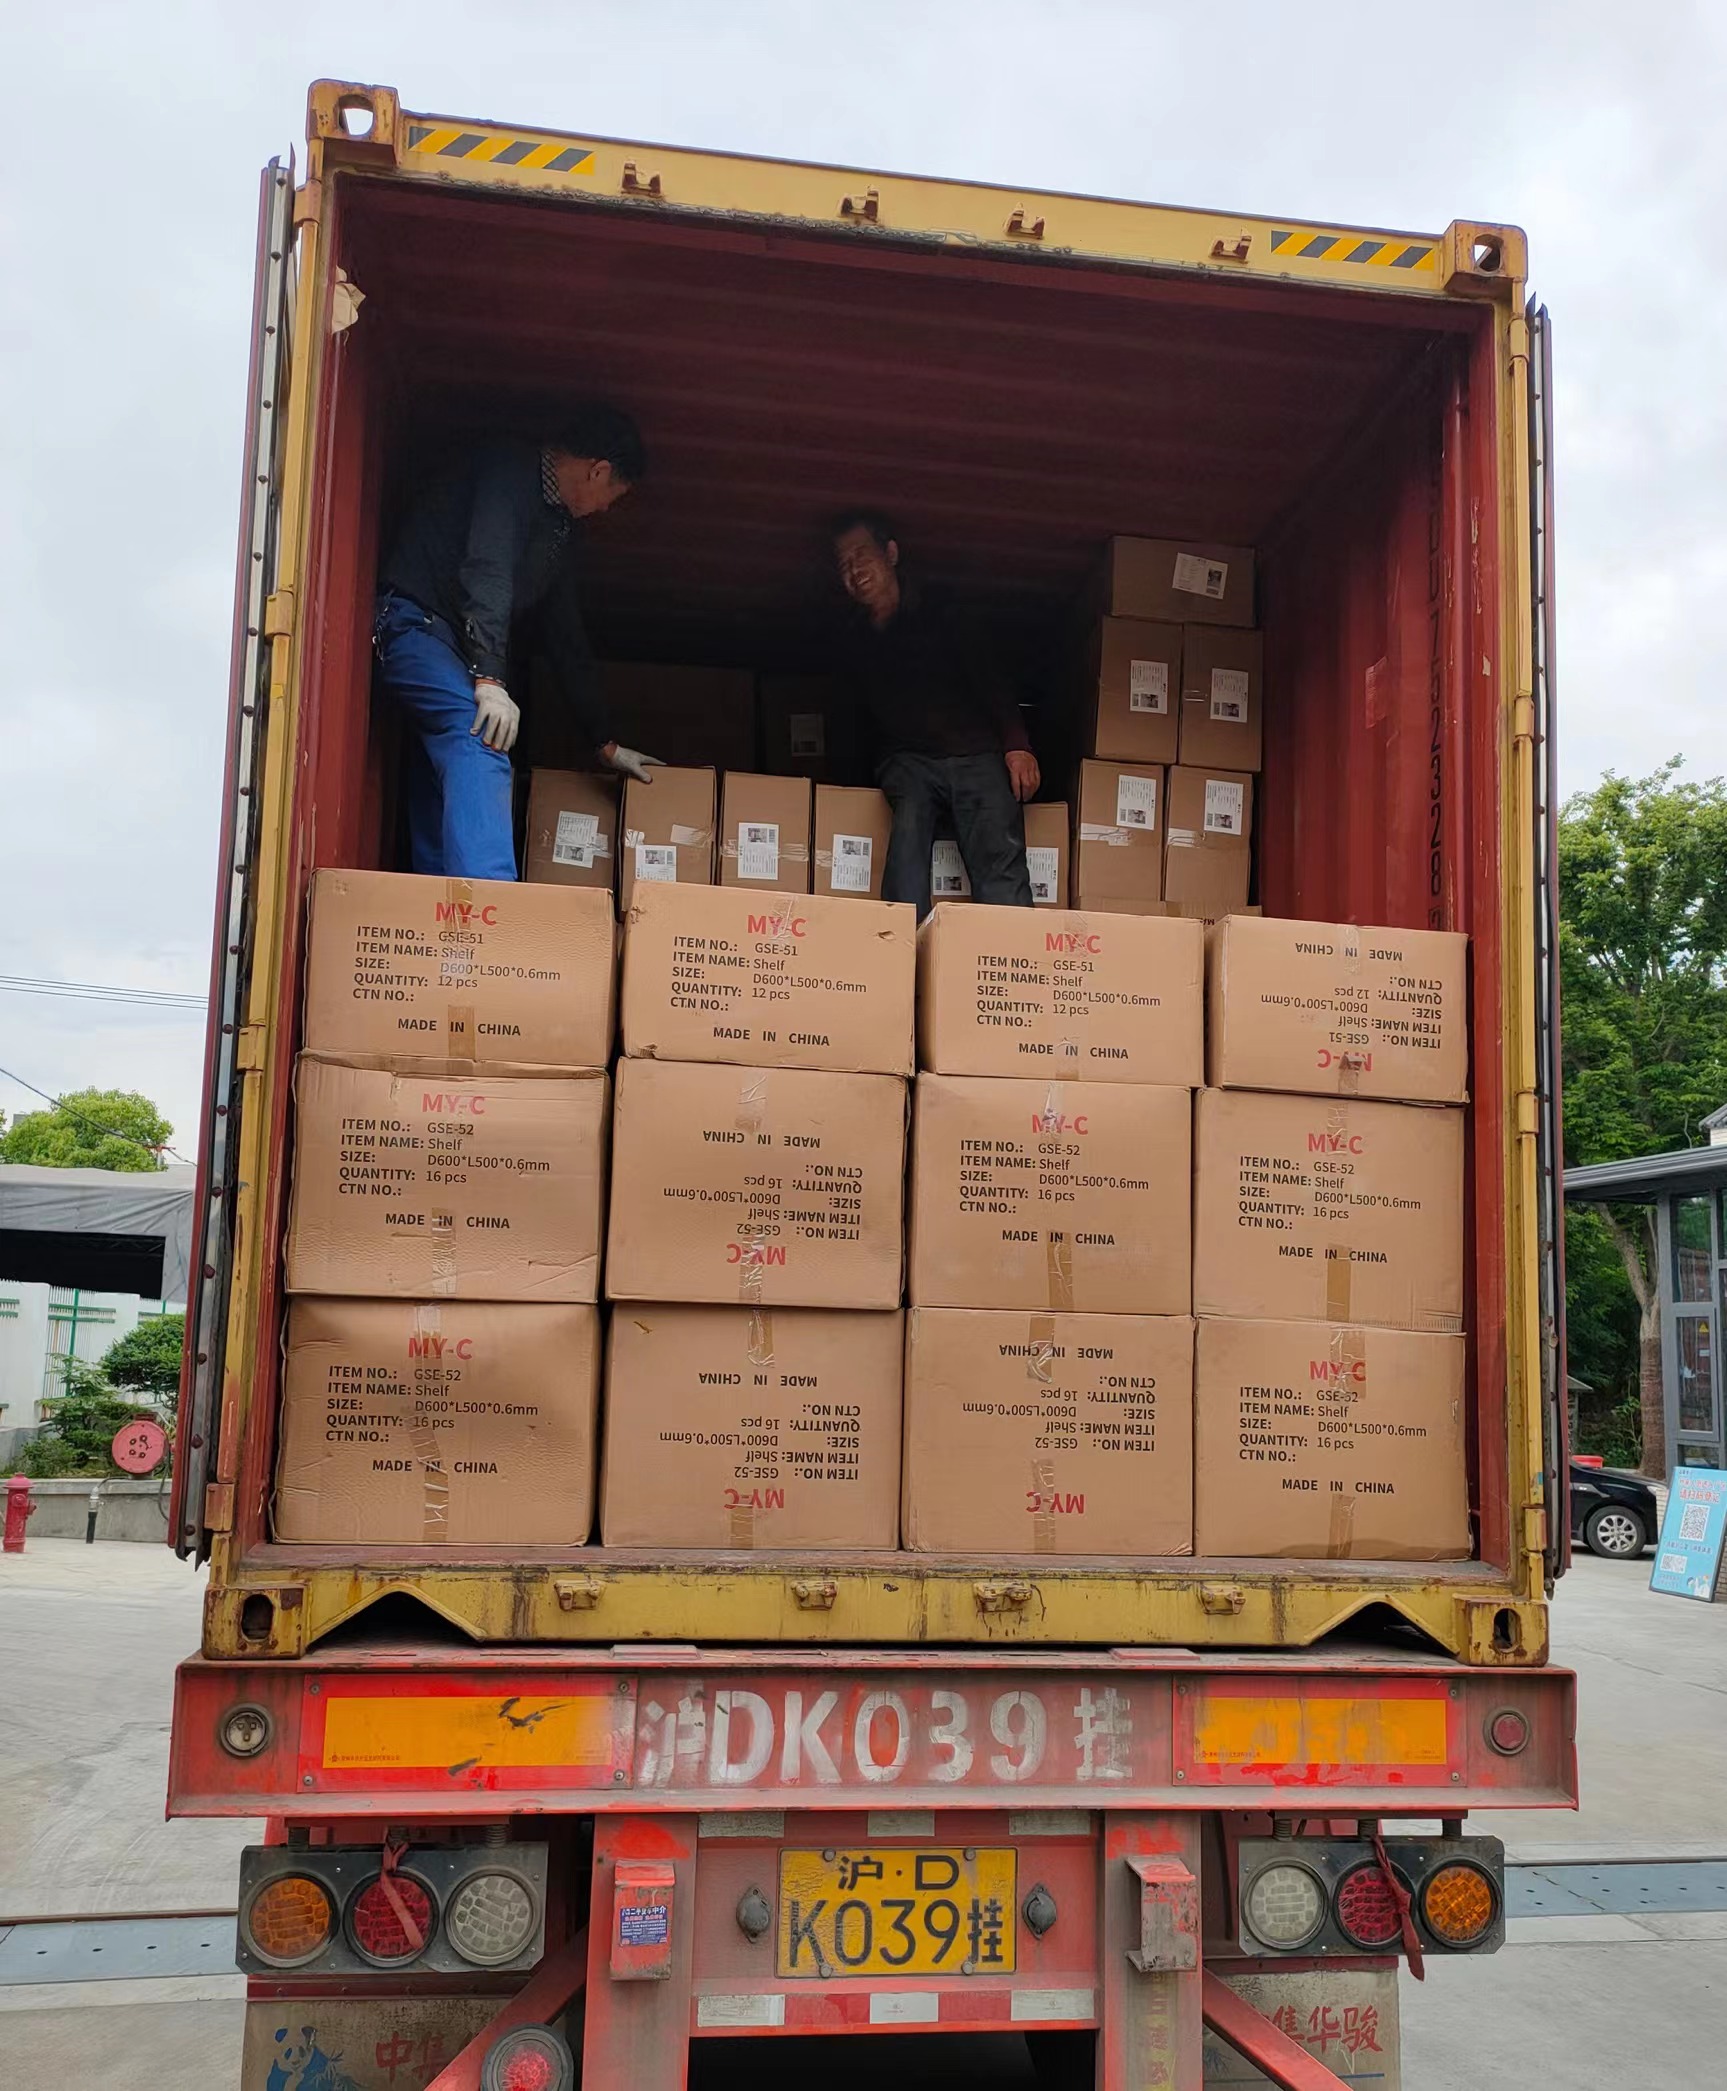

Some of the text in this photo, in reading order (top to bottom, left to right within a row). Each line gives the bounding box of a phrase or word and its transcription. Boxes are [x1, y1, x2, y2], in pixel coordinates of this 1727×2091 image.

[674, 936, 798, 956] ITEM NO.: GSE-51
[1295, 943, 1402, 961] MADE IN CHINA
[355, 957, 390, 969] SIZE:
[673, 952, 785, 971] ITEM NAME: Shelf
[978, 956, 1094, 972] ITEM NO.: GSE-51
[354, 973, 477, 989] QUANTITY: 12 pcs
[672, 967, 704, 979] SIZE:
[977, 971, 1083, 987] ITEM NAME: Shelf
[1390, 976, 1442, 990] CTN NO.:
[670, 997, 728, 1011] CTN NO.:
[977, 1000, 1089, 1017] QUANTITY: 12 pcs
[1412, 1008, 1442, 1019] SIZE:
[398, 1018, 521, 1036] MADE IN CHINA
[1338, 1016, 1441, 1034] ITEM NAME: Shelf
[713, 1027, 830, 1046] MADE IN CHINA
[1329, 1032, 1441, 1049] ITEM NO.: GSE-51
[1019, 1043, 1128, 1059] MADE IN CHINA
[342, 1118, 474, 1136] ITEM NO.: GSE-52
[341, 1134, 462, 1150] ITEM NAME: Shelf
[703, 1130, 820, 1148] MADE IN CHINA
[960, 1140, 1080, 1156] ITEM NO.: GSE-52
[340, 1151, 375, 1163] SIZE:
[960, 1155, 1070, 1170] ITEM NAME: Shelf
[1240, 1156, 1354, 1174] ITEM NO.: GSE-52
[340, 1167, 467, 1184] QUANTITY: 16 pcs
[960, 1171, 992, 1181] SIZE:
[1240, 1171, 1344, 1188] ITEM NAME: Shelf
[744, 1175, 862, 1193] QUANTITY: 16 pcs
[960, 1201, 1016, 1213] CTN NO.:
[1239, 1201, 1349, 1220] QUANTITY: 16 pcs
[748, 1208, 860, 1225] ITEM NAME: Shelf
[737, 1223, 859, 1240] ITEM NO.: GSE-52
[1279, 1246, 1387, 1263] MADE IN CHINA
[329, 1366, 461, 1381] ITEM NO.: GSE-52
[699, 1373, 817, 1386] MADE IN CHINA
[328, 1382, 450, 1396] ITEM NAME: Shelf
[1041, 1389, 1155, 1404] QUANTITY: 16 pcs
[327, 1399, 363, 1410] SIZE:
[803, 1404, 860, 1416] CTN NO.:
[1240, 1402, 1349, 1418] ITEM NAME: Shelf
[1124, 1409, 1155, 1419] SIZE:
[327, 1415, 454, 1430] QUANTITY: 16 pcs
[1240, 1418, 1271, 1429] SIZE:
[827, 1437, 859, 1448] SIZE:
[1035, 1437, 1154, 1451] ITEM NO.: GSE-52
[1240, 1434, 1354, 1450] QUANTITY: 16 pcs
[745, 1451, 858, 1464] ITEM NAME: Shelf
[735, 1467, 858, 1480] ITEM NO.: GSE-52
[1282, 1479, 1394, 1494] MADE IN CHINA
